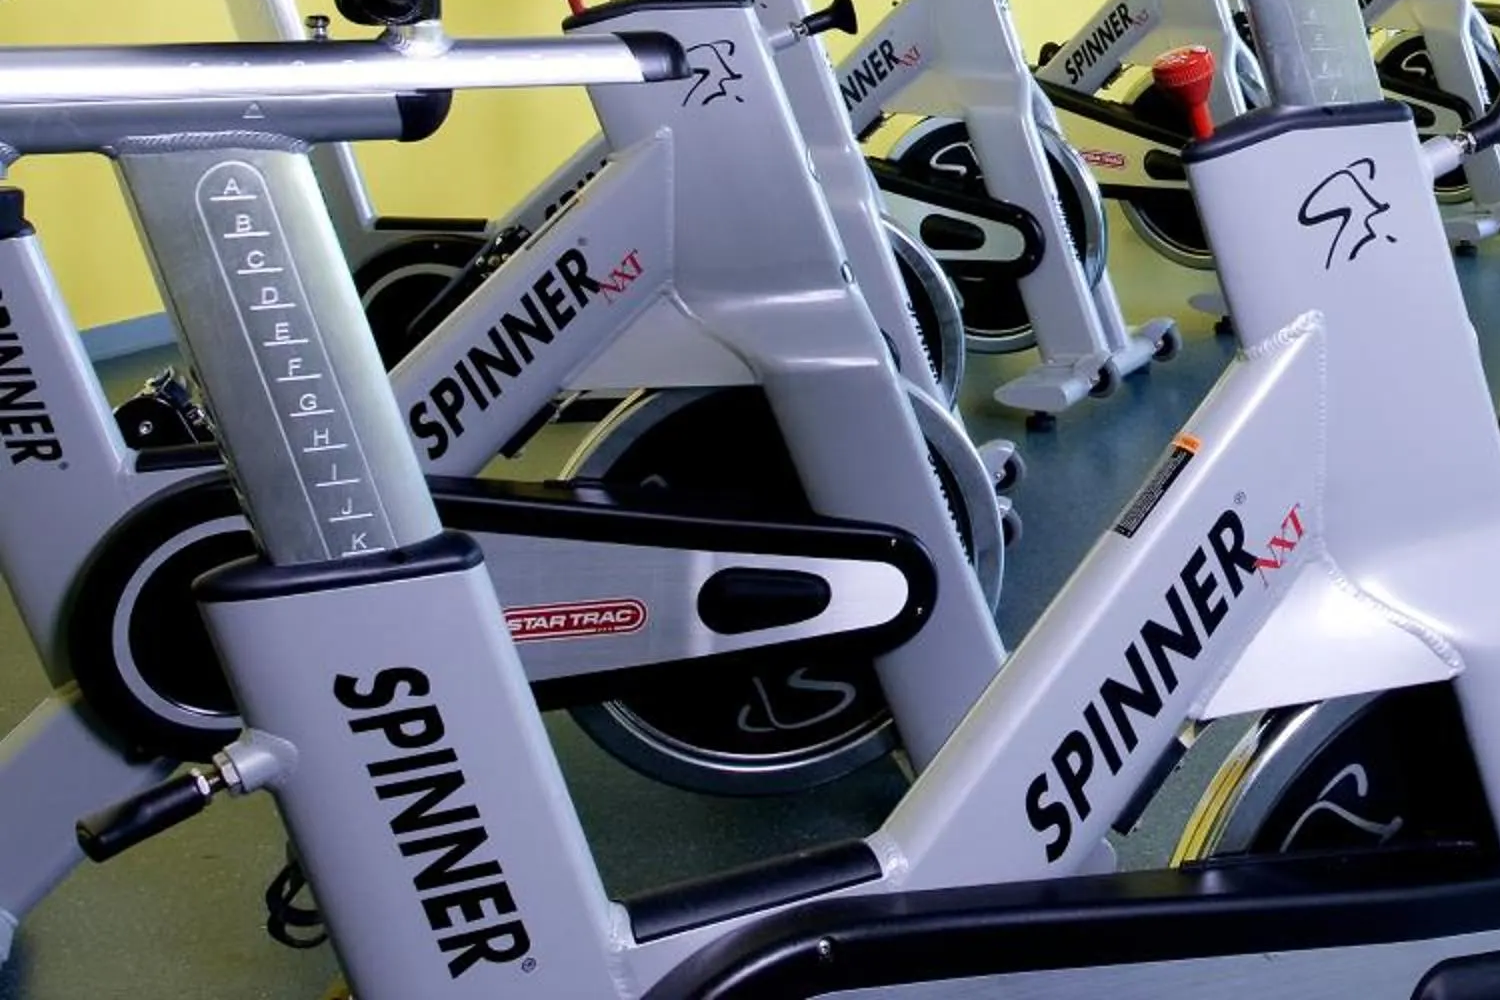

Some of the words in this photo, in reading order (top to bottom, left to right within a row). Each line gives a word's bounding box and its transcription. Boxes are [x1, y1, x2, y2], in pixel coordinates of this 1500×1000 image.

[1065, 2, 1134, 85] SPINNER
[223, 178, 241, 195] A
[236, 214, 252, 233] B
[247, 251, 265, 268] C
[261, 286, 280, 305] D
[275, 322, 289, 341] E
[409, 248, 600, 460] SPINNER
[600, 248, 644, 304] NXT
[288, 358, 303, 376] F
[0, 288, 63, 466] NNER
[299, 394, 318, 412] G
[313, 428, 330, 446] H
[342, 499, 352, 516] J
[352, 533, 367, 550] K
[507, 615, 566, 631] STAR
[569, 609, 632, 626] TRAC
[1026, 509, 1258, 863] SPINNER
[1252, 502, 1305, 588] NXT
[333, 666, 531, 979] SPINNER
